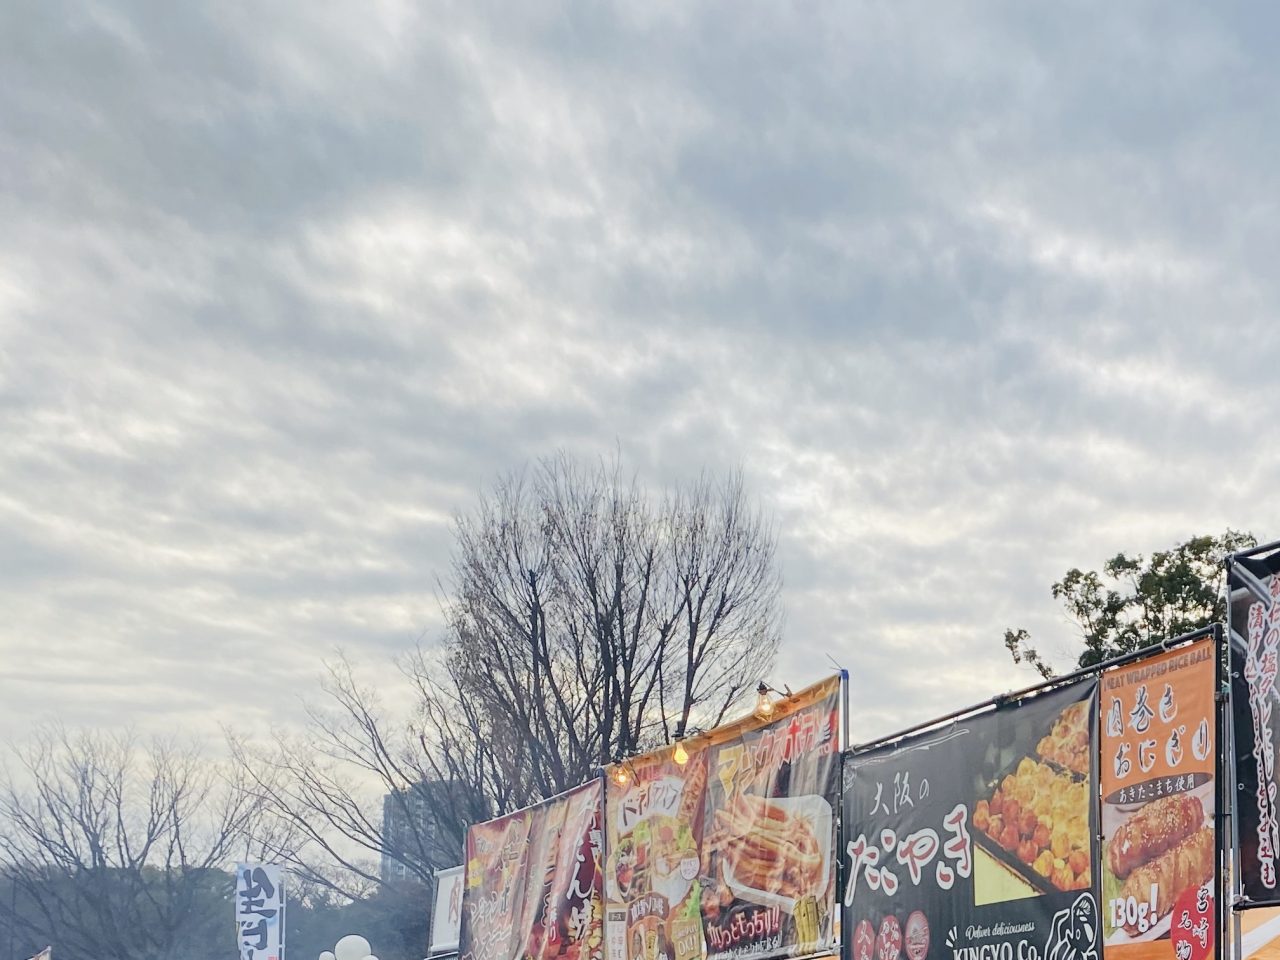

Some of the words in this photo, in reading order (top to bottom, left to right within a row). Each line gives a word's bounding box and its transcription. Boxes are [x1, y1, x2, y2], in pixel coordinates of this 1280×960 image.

[1104, 674, 1125, 692] MEAT
[1126, 663, 1167, 686] WRAPPED
[1168, 658, 1188, 675] RICE
[1189, 653, 1212, 669] BALL
[1106, 683, 1180, 737] 肉巻き
[1114, 720, 1212, 779] おにぎり
[869, 771, 931, 816] 大阪の
[1118, 777, 1196, 804] あきたこまち使用
[966, 923, 990, 941] Deliver
[992, 920, 1035, 937] deliciousness
[1109, 883, 1158, 934] 130g!
[1193, 888, 1209, 950] 宮崎
